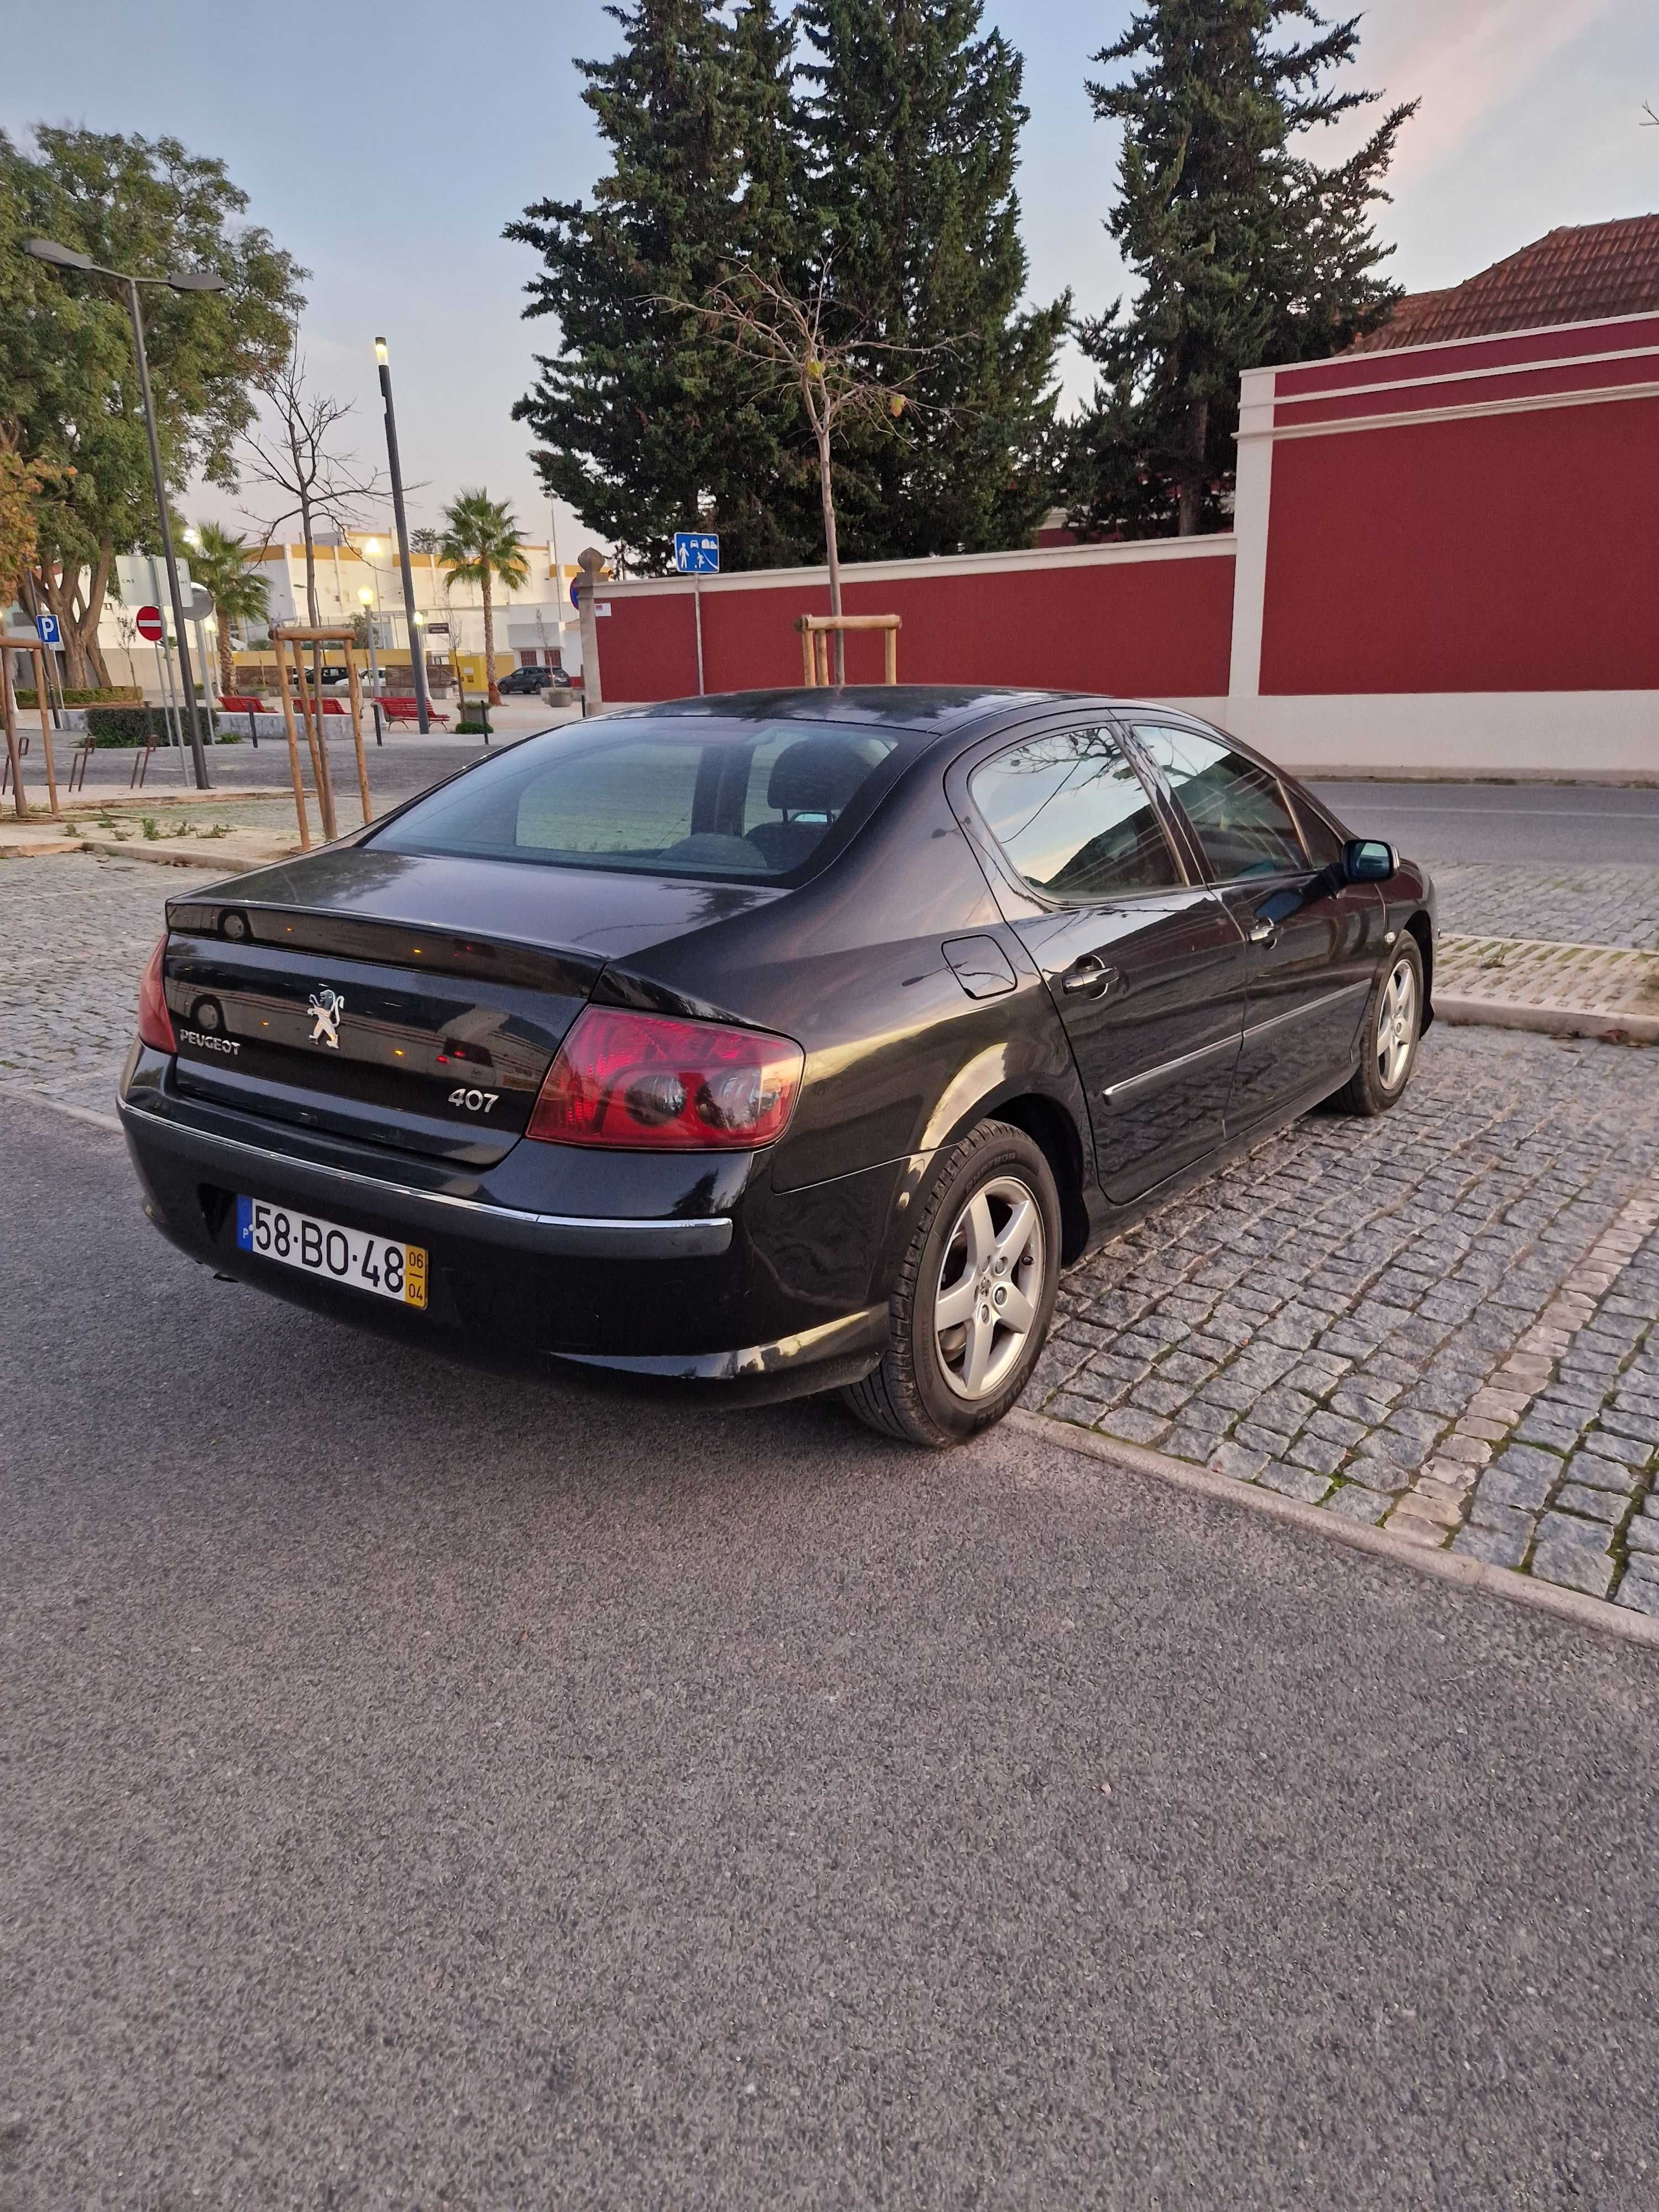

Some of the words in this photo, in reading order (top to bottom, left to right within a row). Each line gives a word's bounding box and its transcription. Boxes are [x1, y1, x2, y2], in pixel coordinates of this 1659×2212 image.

[41, 618, 54, 640] P
[180, 1029, 241, 1055] PEUGEOT
[448, 1088, 499, 1113] 407
[243, 1228, 249, 1239] P
[409, 1251, 424, 1269] 06
[409, 1283, 423, 1301] 04
